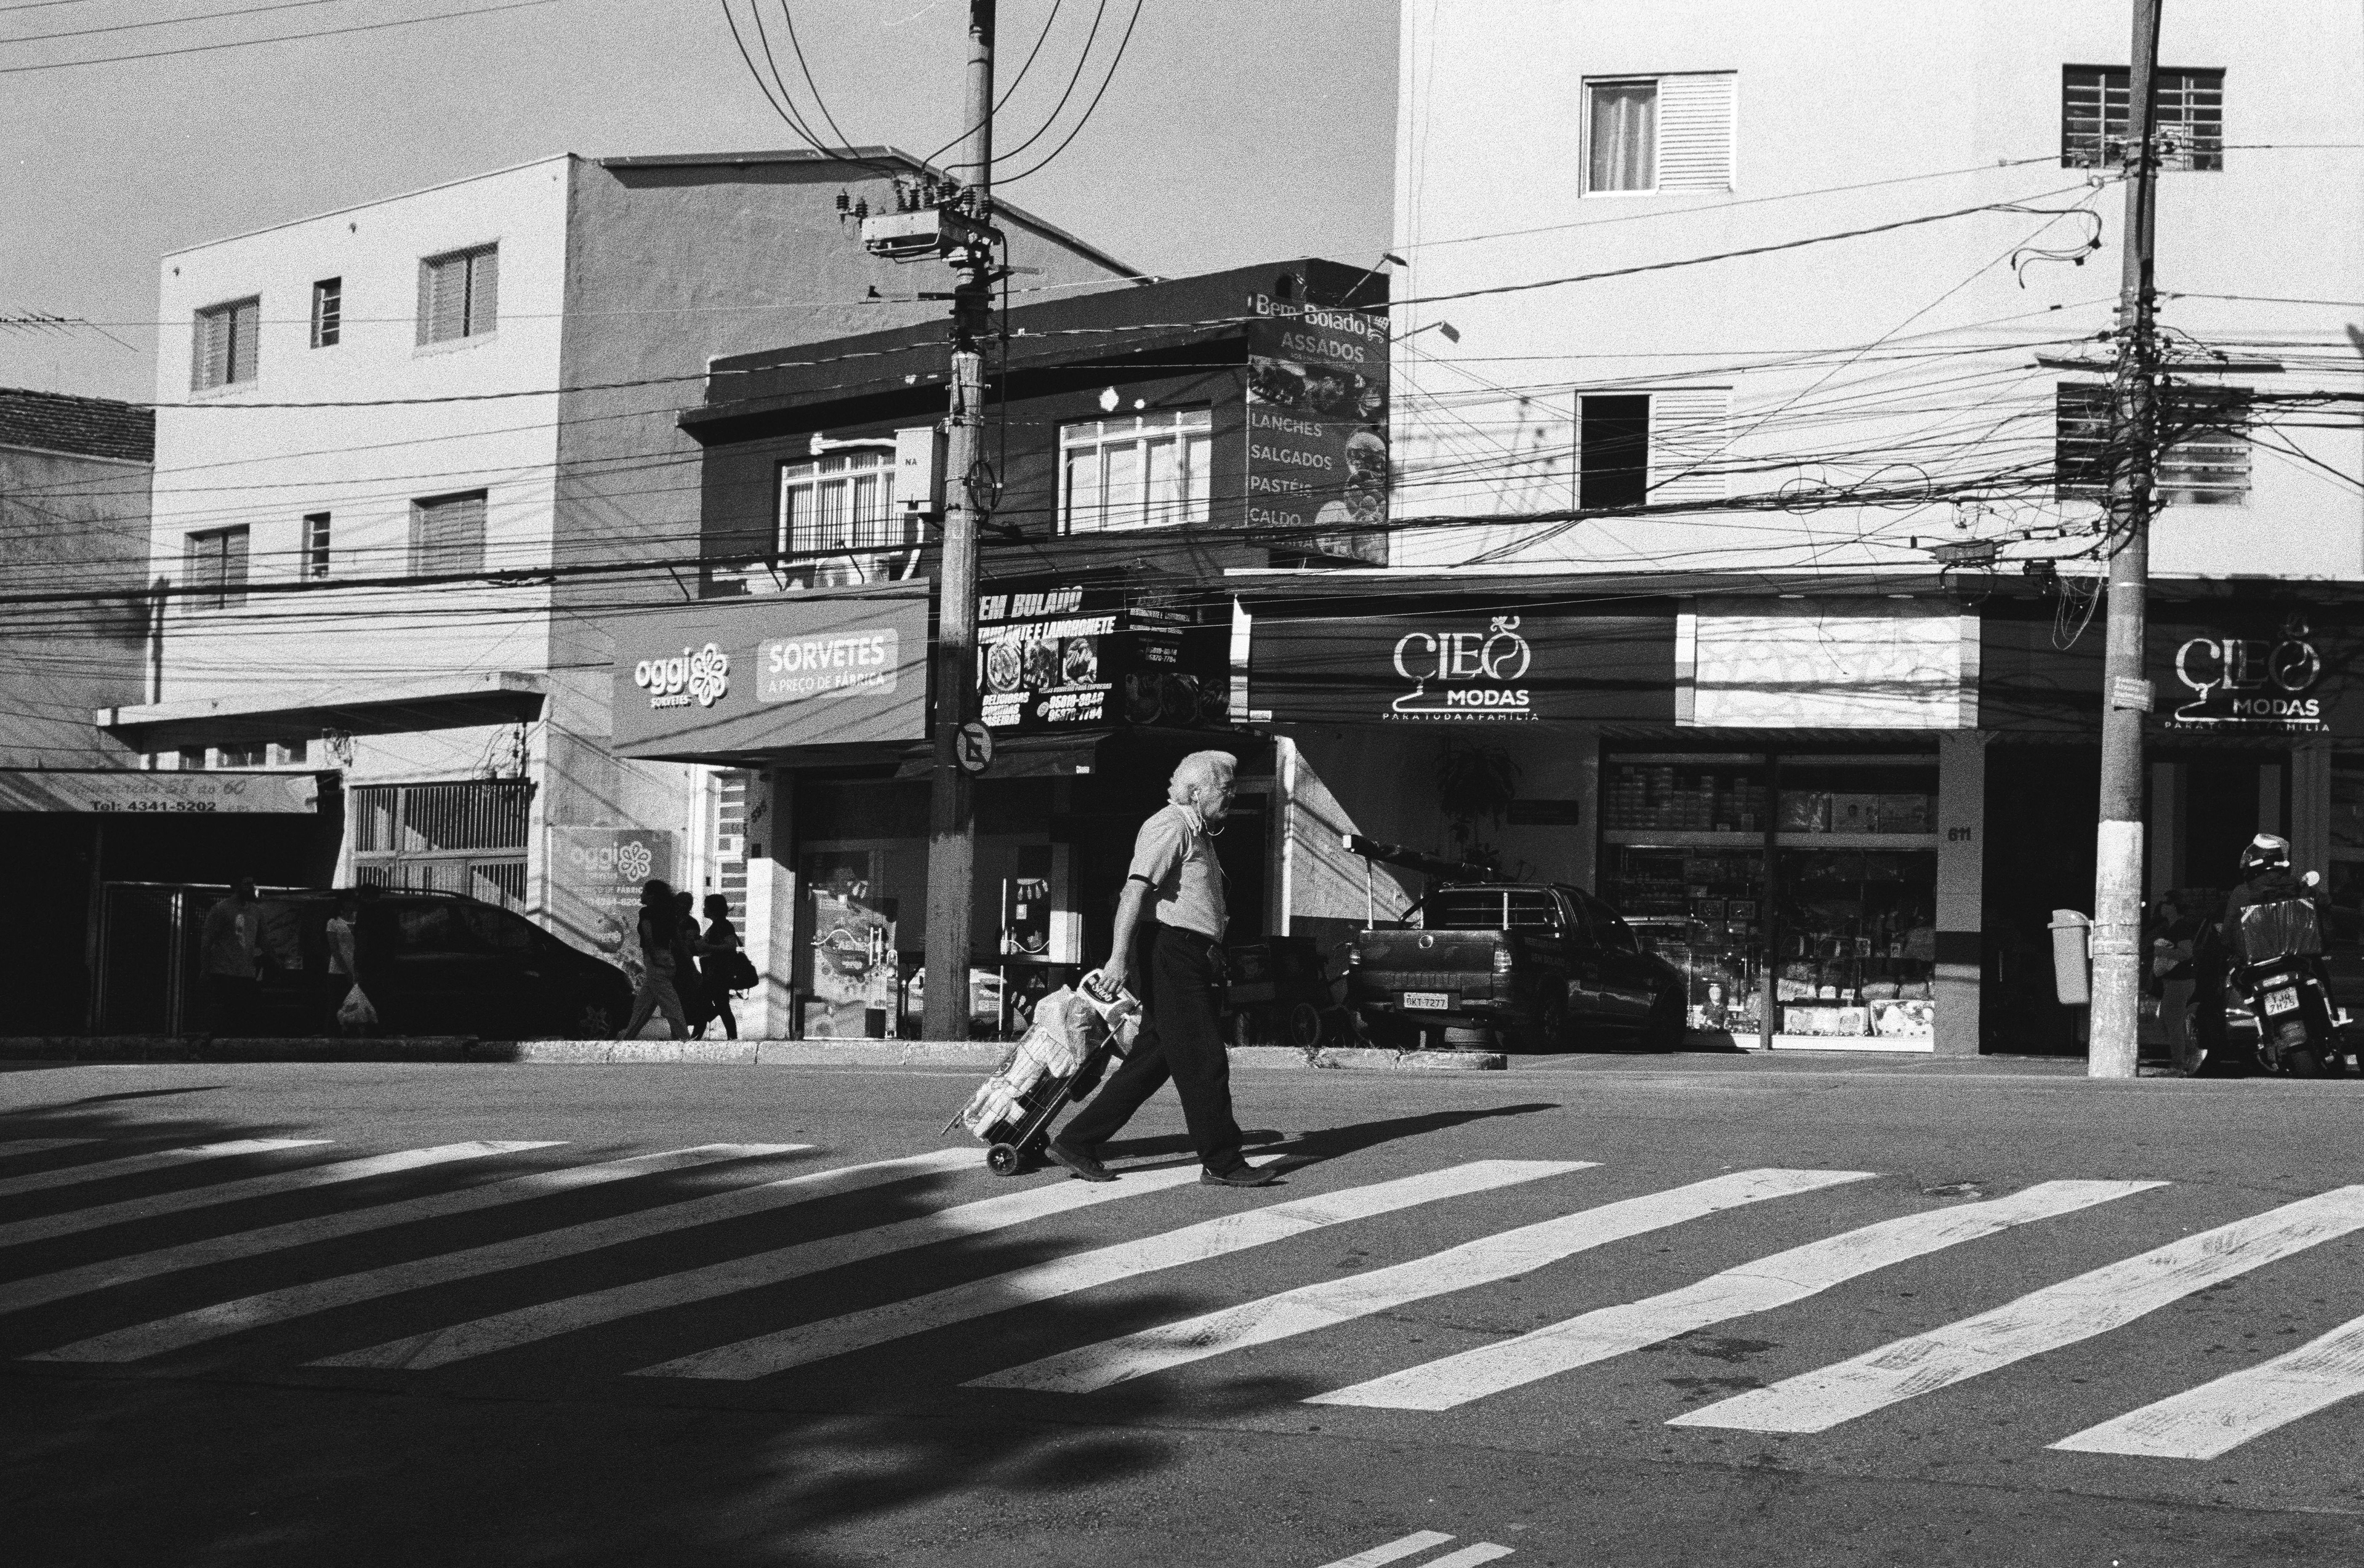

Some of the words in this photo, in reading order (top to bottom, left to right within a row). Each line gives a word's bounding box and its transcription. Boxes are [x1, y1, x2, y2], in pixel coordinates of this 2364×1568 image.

[1256, 294, 1296, 320] Bem
[1305, 304, 1365, 334] Bolado
[1281, 332, 1364, 363] ASSADOS
[1252, 413, 1322, 436] LANCHES
[1251, 444, 1332, 470] SALGADOS
[1250, 507, 1301, 526] CALDO
[770, 636, 885, 673] SORVETES
[635, 646, 690, 694] oggi
[1447, 690, 1529, 706] MODAS
[2233, 699, 2319, 716] MODAS
[92, 801, 121, 811] Tel:
[128, 801, 216, 811] 4341-5202
[1948, 827, 1971, 842] 611
[571, 841, 618, 870] oggi
[617, 885, 643, 894] FÁBRIC
